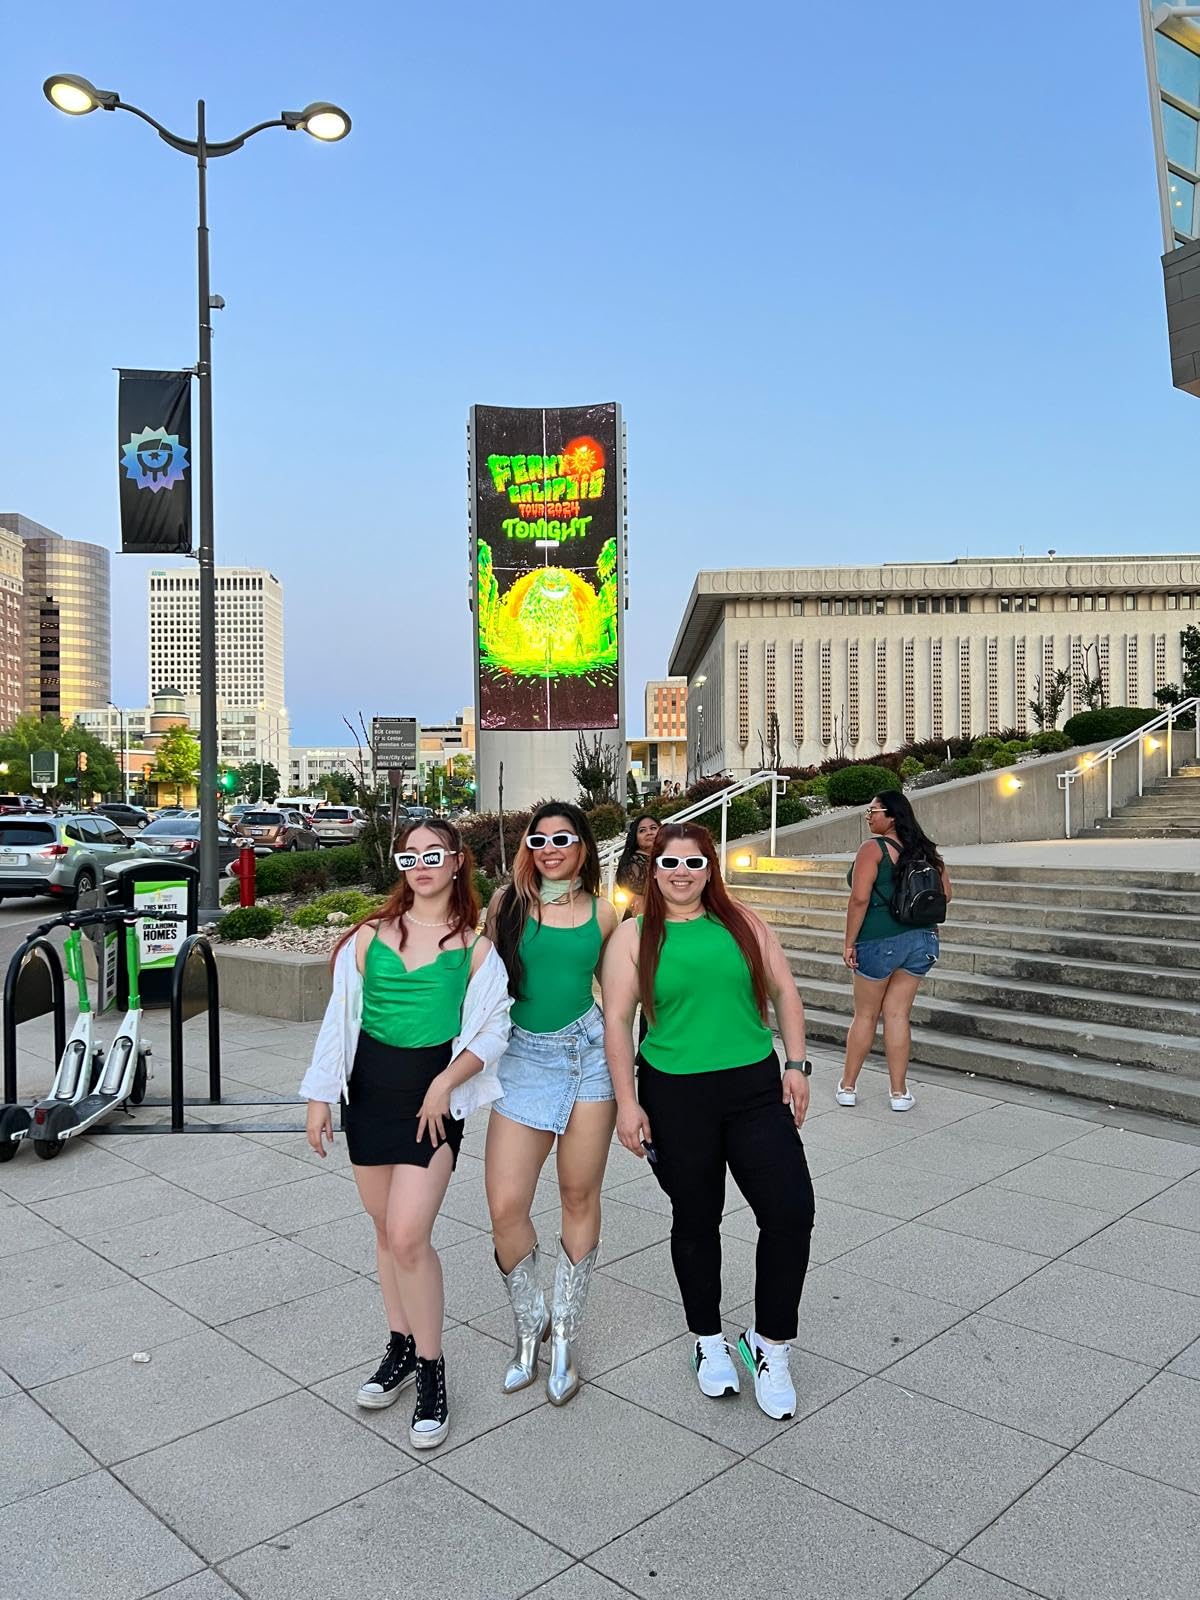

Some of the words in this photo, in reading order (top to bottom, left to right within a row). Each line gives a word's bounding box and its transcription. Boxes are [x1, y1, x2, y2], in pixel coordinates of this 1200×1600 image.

[518, 502, 545, 518] TOUR
[547, 501, 581, 518] 2024
[502, 515, 593, 541] TONIGHT
[144, 929, 176, 940] HOMES
